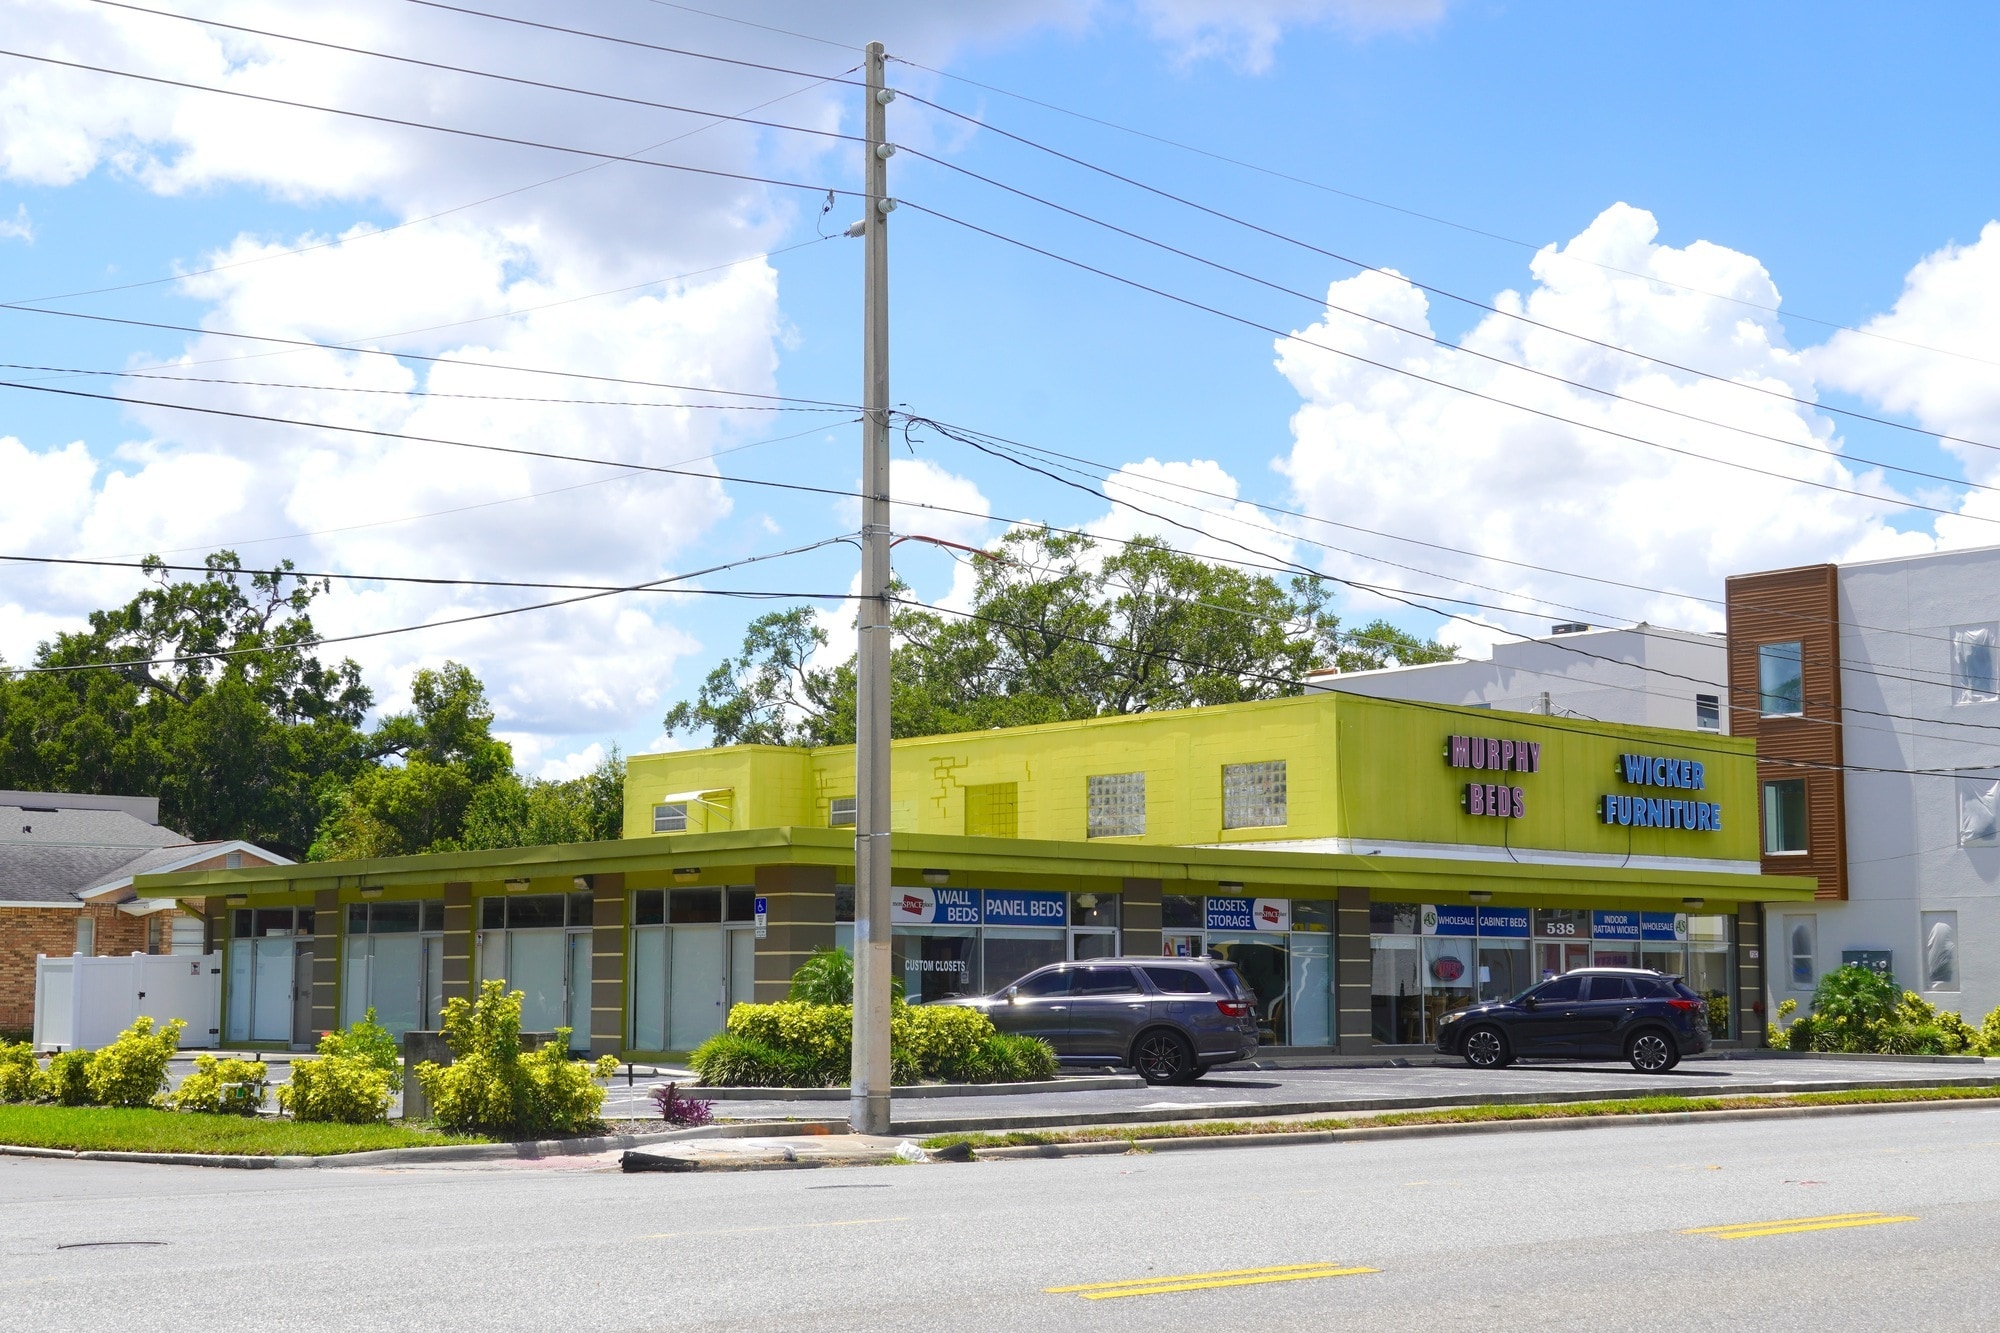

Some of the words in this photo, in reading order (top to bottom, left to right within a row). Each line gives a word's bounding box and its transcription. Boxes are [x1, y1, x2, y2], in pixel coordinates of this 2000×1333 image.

[1450, 735, 1541, 773] MURPHY
[1621, 754, 1705, 790] WICKER
[1468, 783, 1525, 819] BEDS
[1603, 795, 1722, 831] FURNITURE
[937, 889, 972, 905] WALL
[986, 899, 1028, 917] PANEL
[1030, 900, 1064, 918] BEDS
[1207, 899, 1249, 914] CLOSETS,
[947, 907, 979, 922] BEDS
[1207, 914, 1251, 928] STORAGE
[1437, 916, 1475, 926] WHOLESALE
[1479, 917, 1508, 927] CABINET
[1509, 917, 1528, 928] BEDS
[1604, 915, 1628, 924] INDOOR
[1546, 922, 1575, 935] 538
[1593, 924, 1615, 934] RATTAN
[1616, 925, 1639, 935] WICKER
[1641, 922, 1674, 931] WHOLESALE
[905, 960, 934, 972] CUSTOM
[935, 960, 966, 973] CLOSETS
